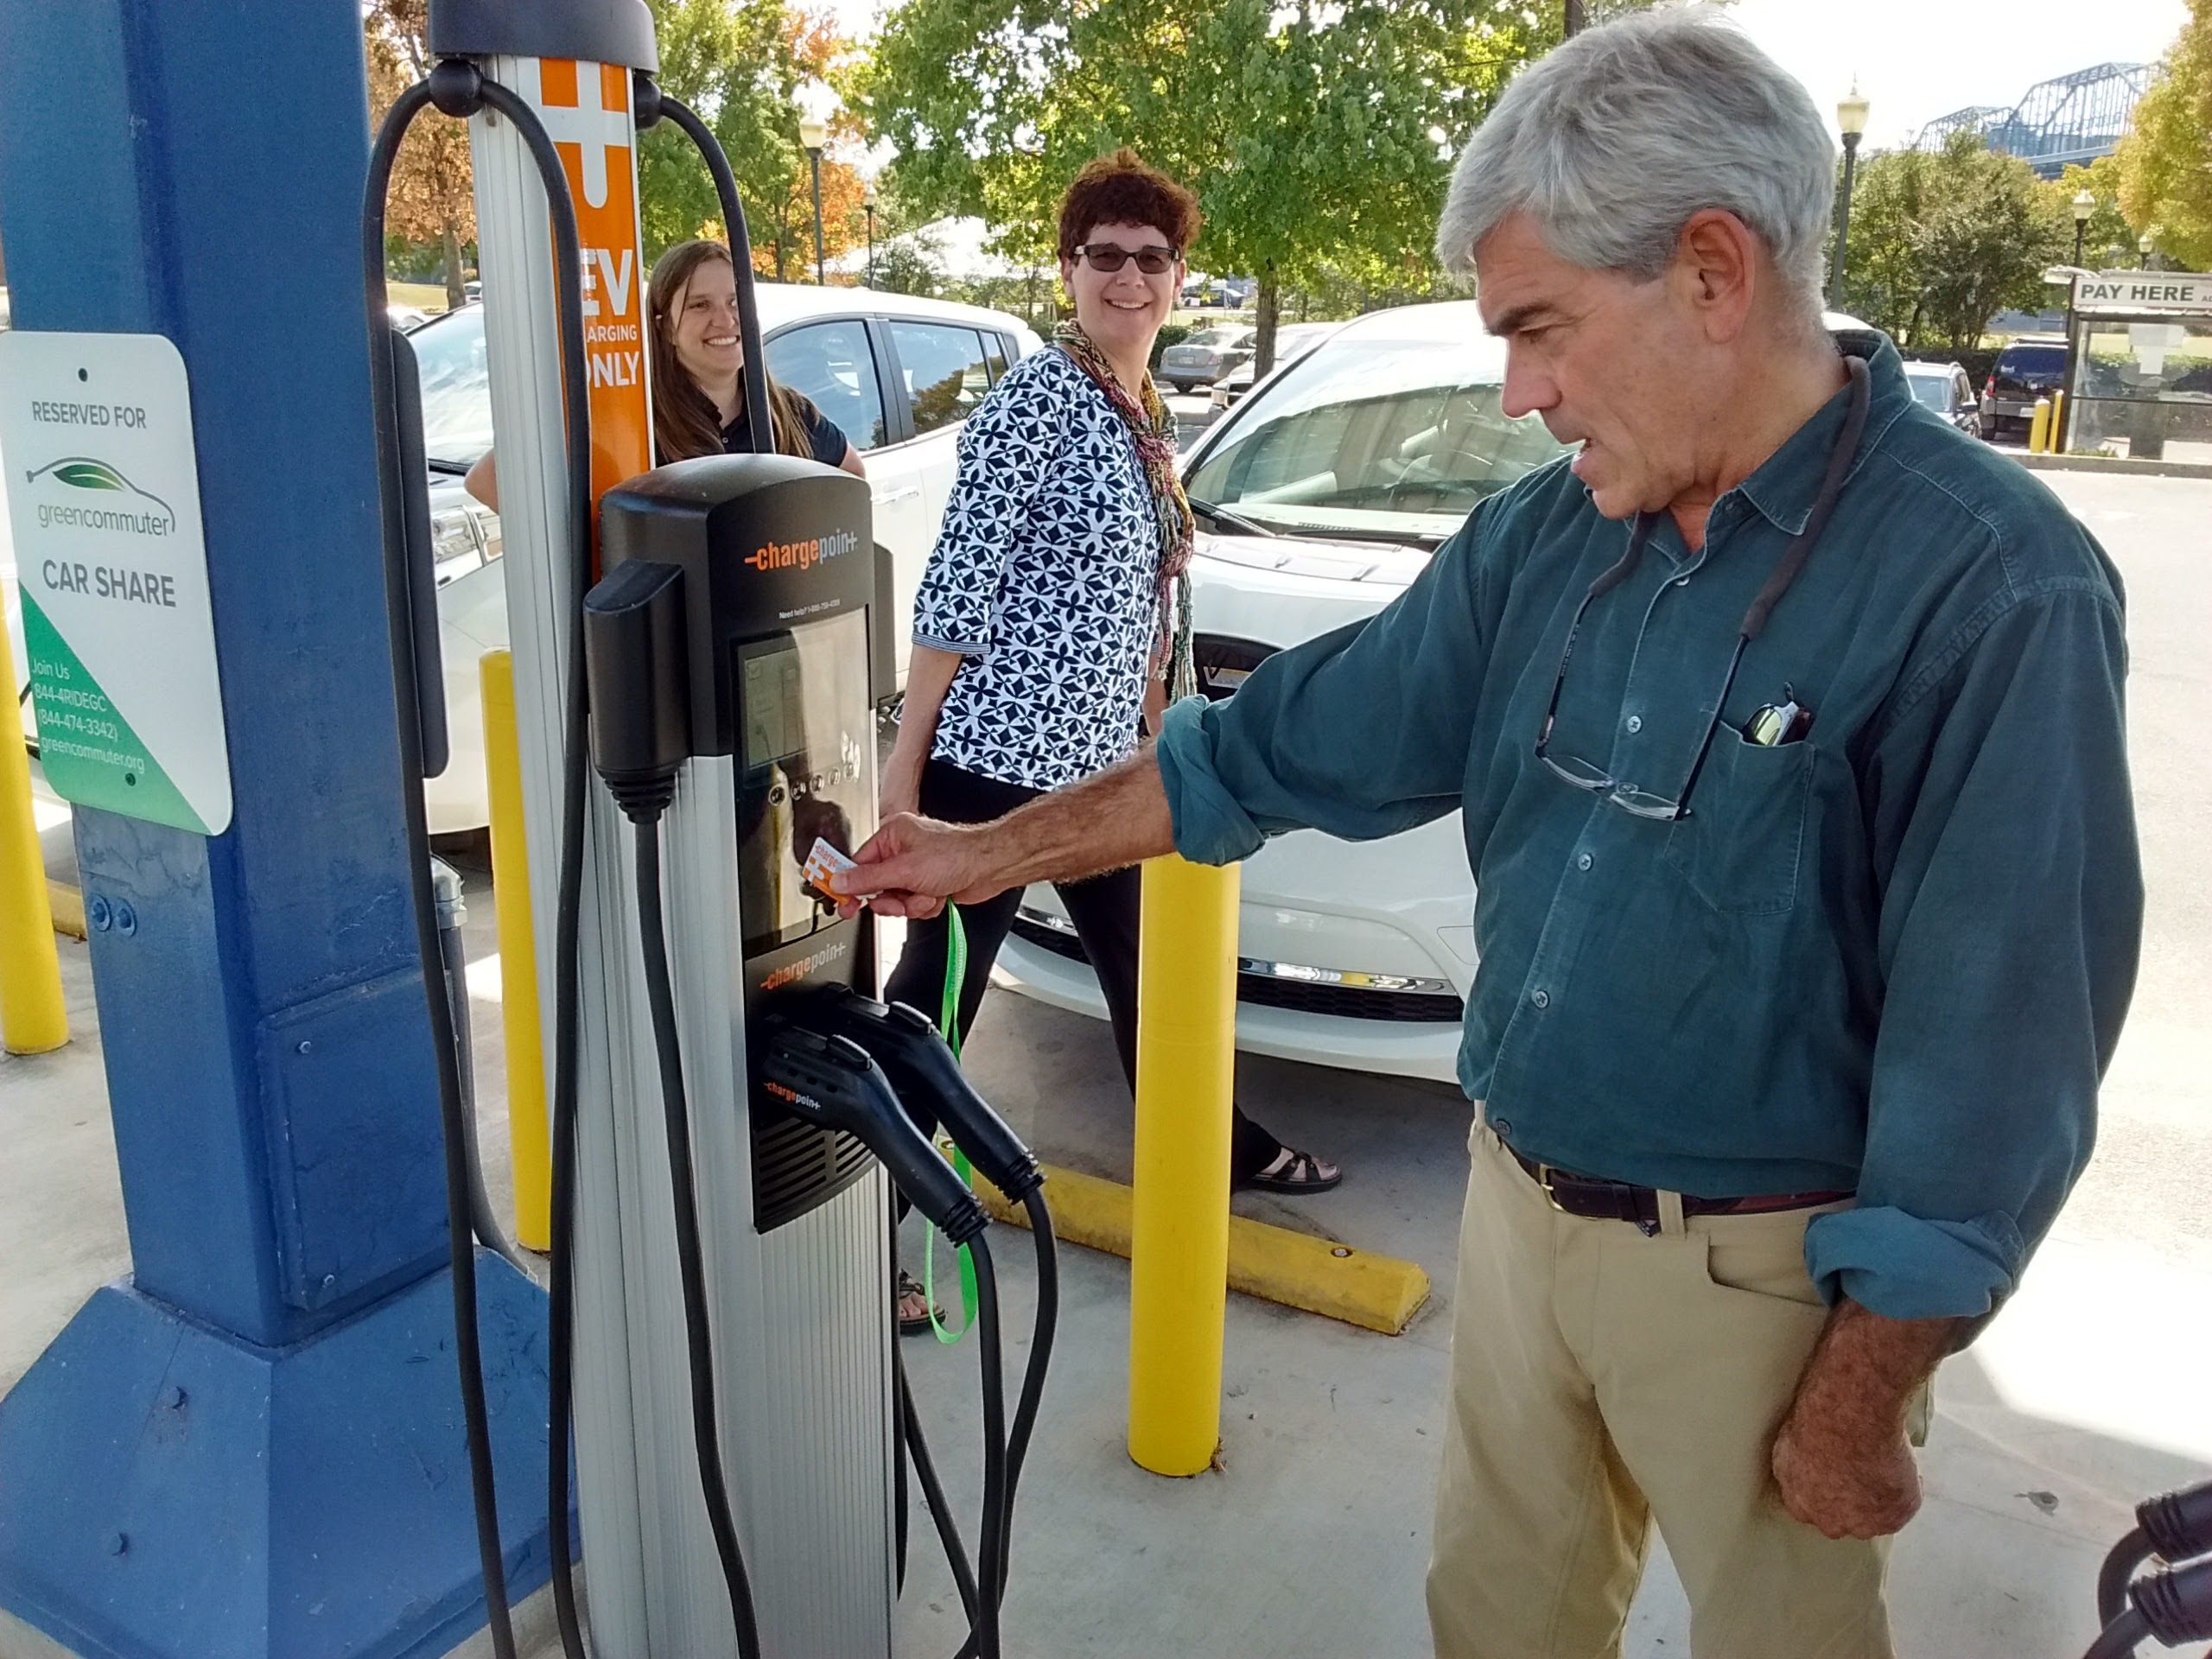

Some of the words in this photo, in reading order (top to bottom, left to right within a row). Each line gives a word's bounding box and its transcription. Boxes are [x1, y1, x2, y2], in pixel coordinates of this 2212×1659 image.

[580, 248, 633, 316] EV
[2081, 284, 2123, 299] PAY
[2131, 285, 2194, 302] HERE
[587, 324, 638, 343] ARGING
[587, 351, 639, 388] NLY
[32, 401, 111, 426] RESERVED
[114, 406, 147, 429] FOR
[38, 504, 169, 536] greencommuter
[42, 559, 90, 594] CAR
[95, 566, 176, 607] SHARE
[32, 658, 53, 677] Join
[54, 662, 70, 680] Us
[34, 683, 106, 712] 844-4RIDEGC
[37, 709, 118, 743] (844-474-3342)
[41, 737, 145, 773] greencommuter.org
